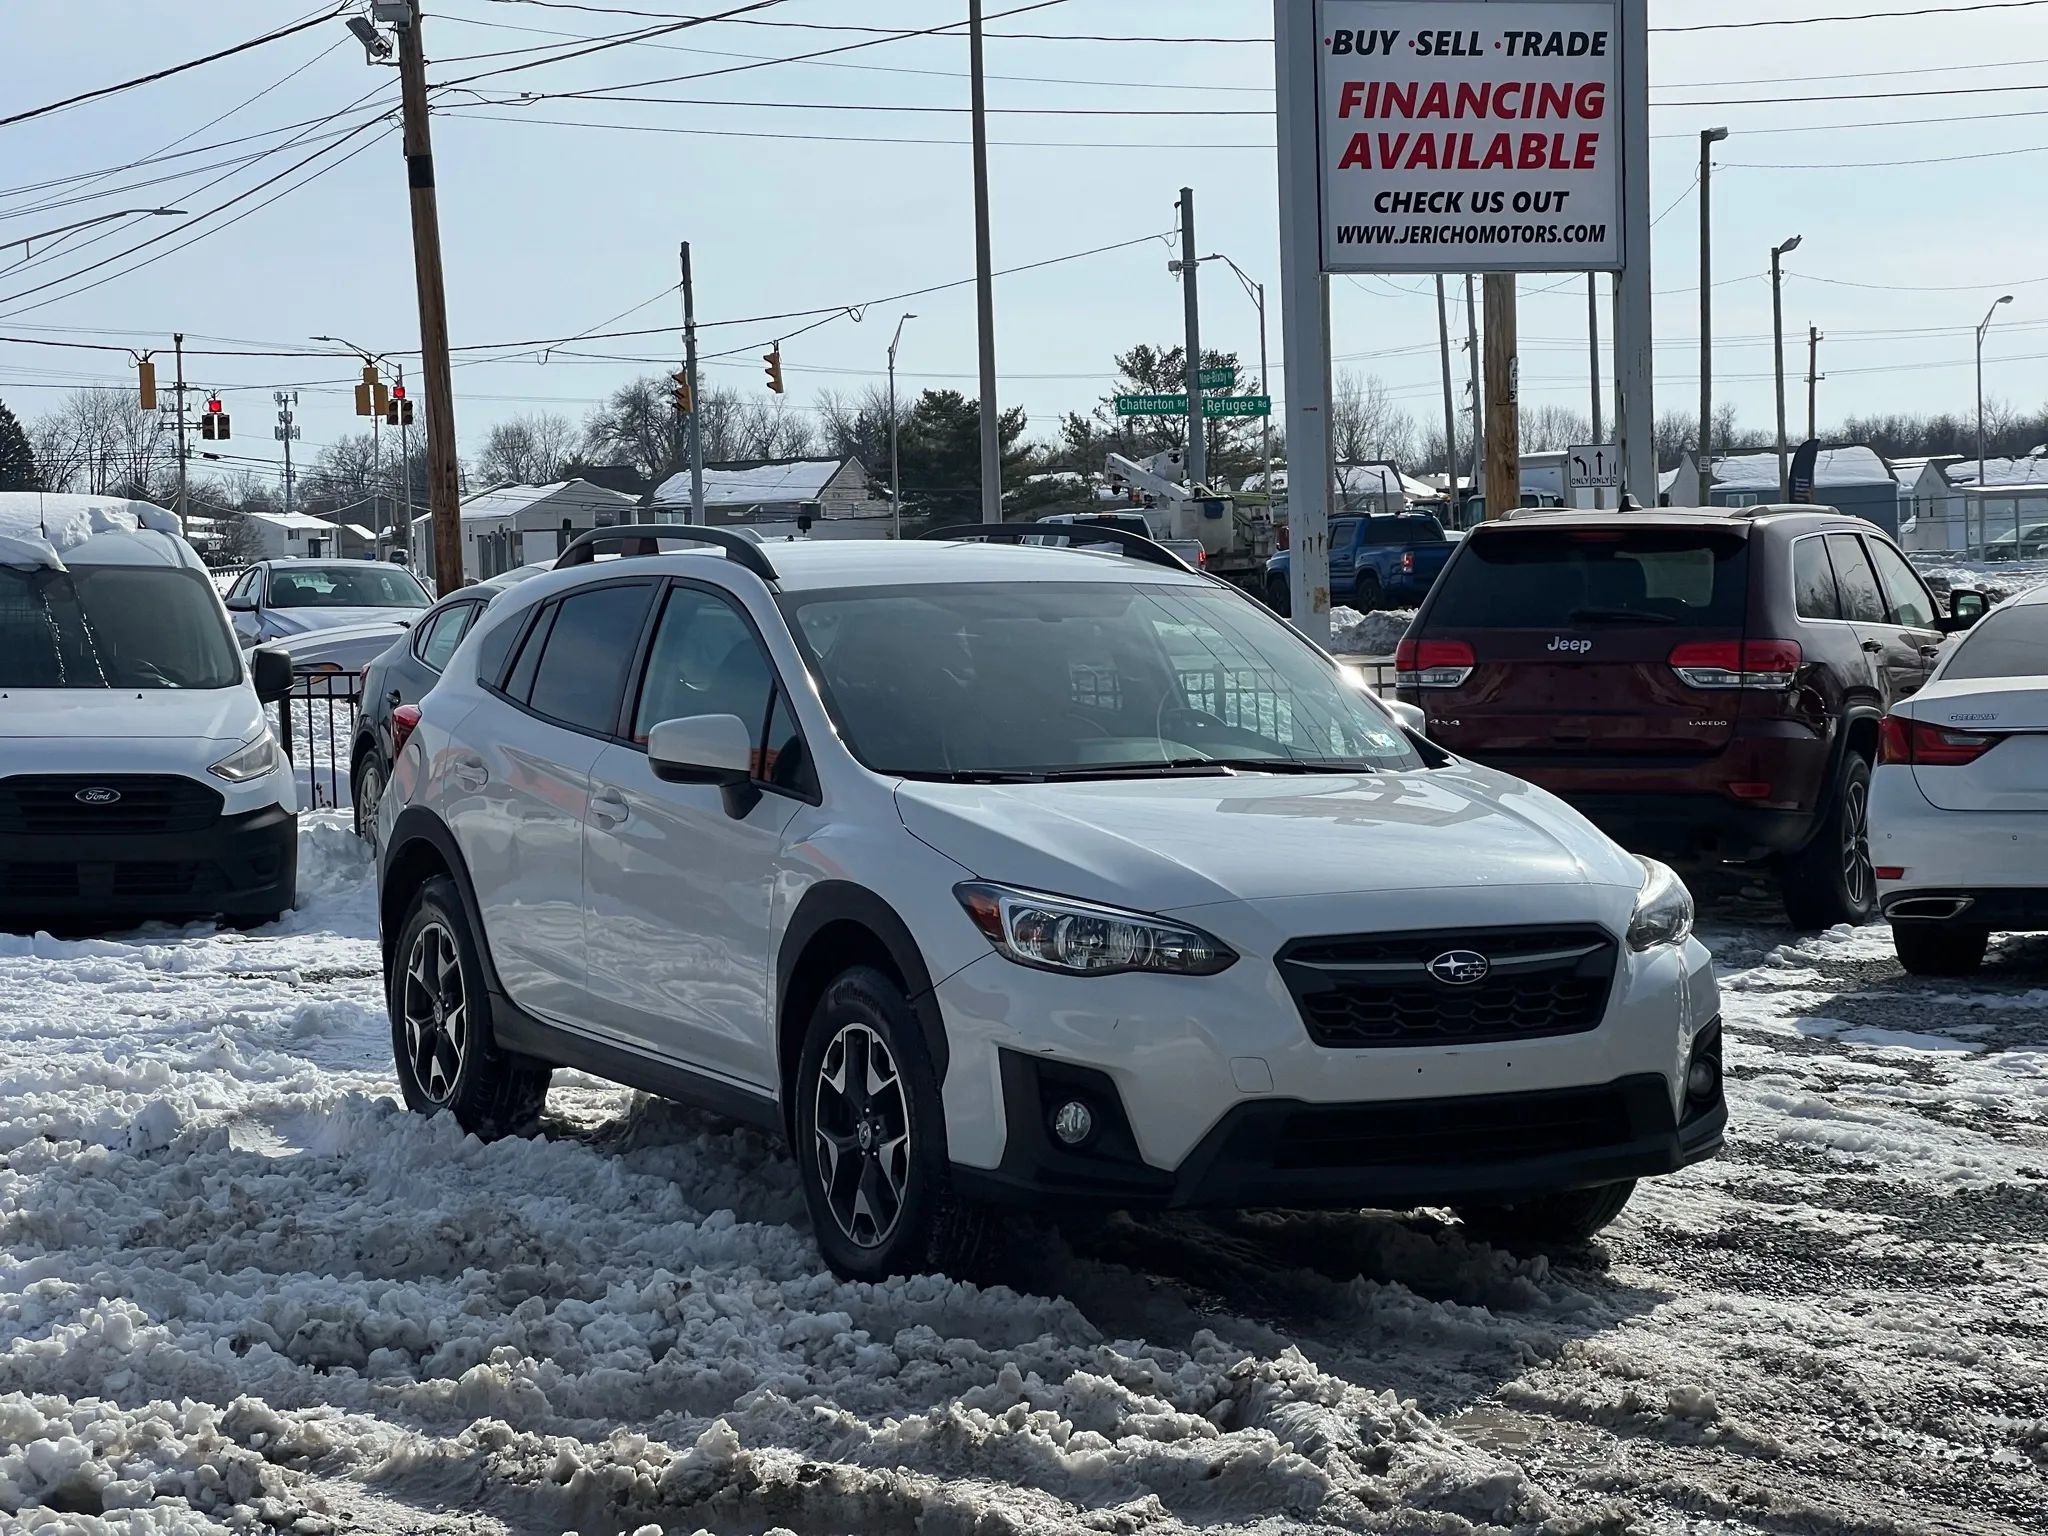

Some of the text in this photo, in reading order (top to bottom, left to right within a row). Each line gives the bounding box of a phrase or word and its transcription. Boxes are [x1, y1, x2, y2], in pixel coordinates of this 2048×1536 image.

[1331, 30, 1608, 57] BUY SELL TRADE
[1337, 81, 1605, 119] FINANCING
[1337, 132, 1599, 170] AVAILABLE
[1373, 191, 1570, 214] CHECK US OUT
[1336, 224, 1606, 244] WWW.JERICHOMOTORS.COM
[1119, 398, 1186, 411] Chatterton Rd
[1207, 399, 1267, 414] Refugee Rd
[1571, 477, 1589, 485] ONLY
[1547, 636, 1592, 654] Jeep
[86, 789, 111, 801] Ford
